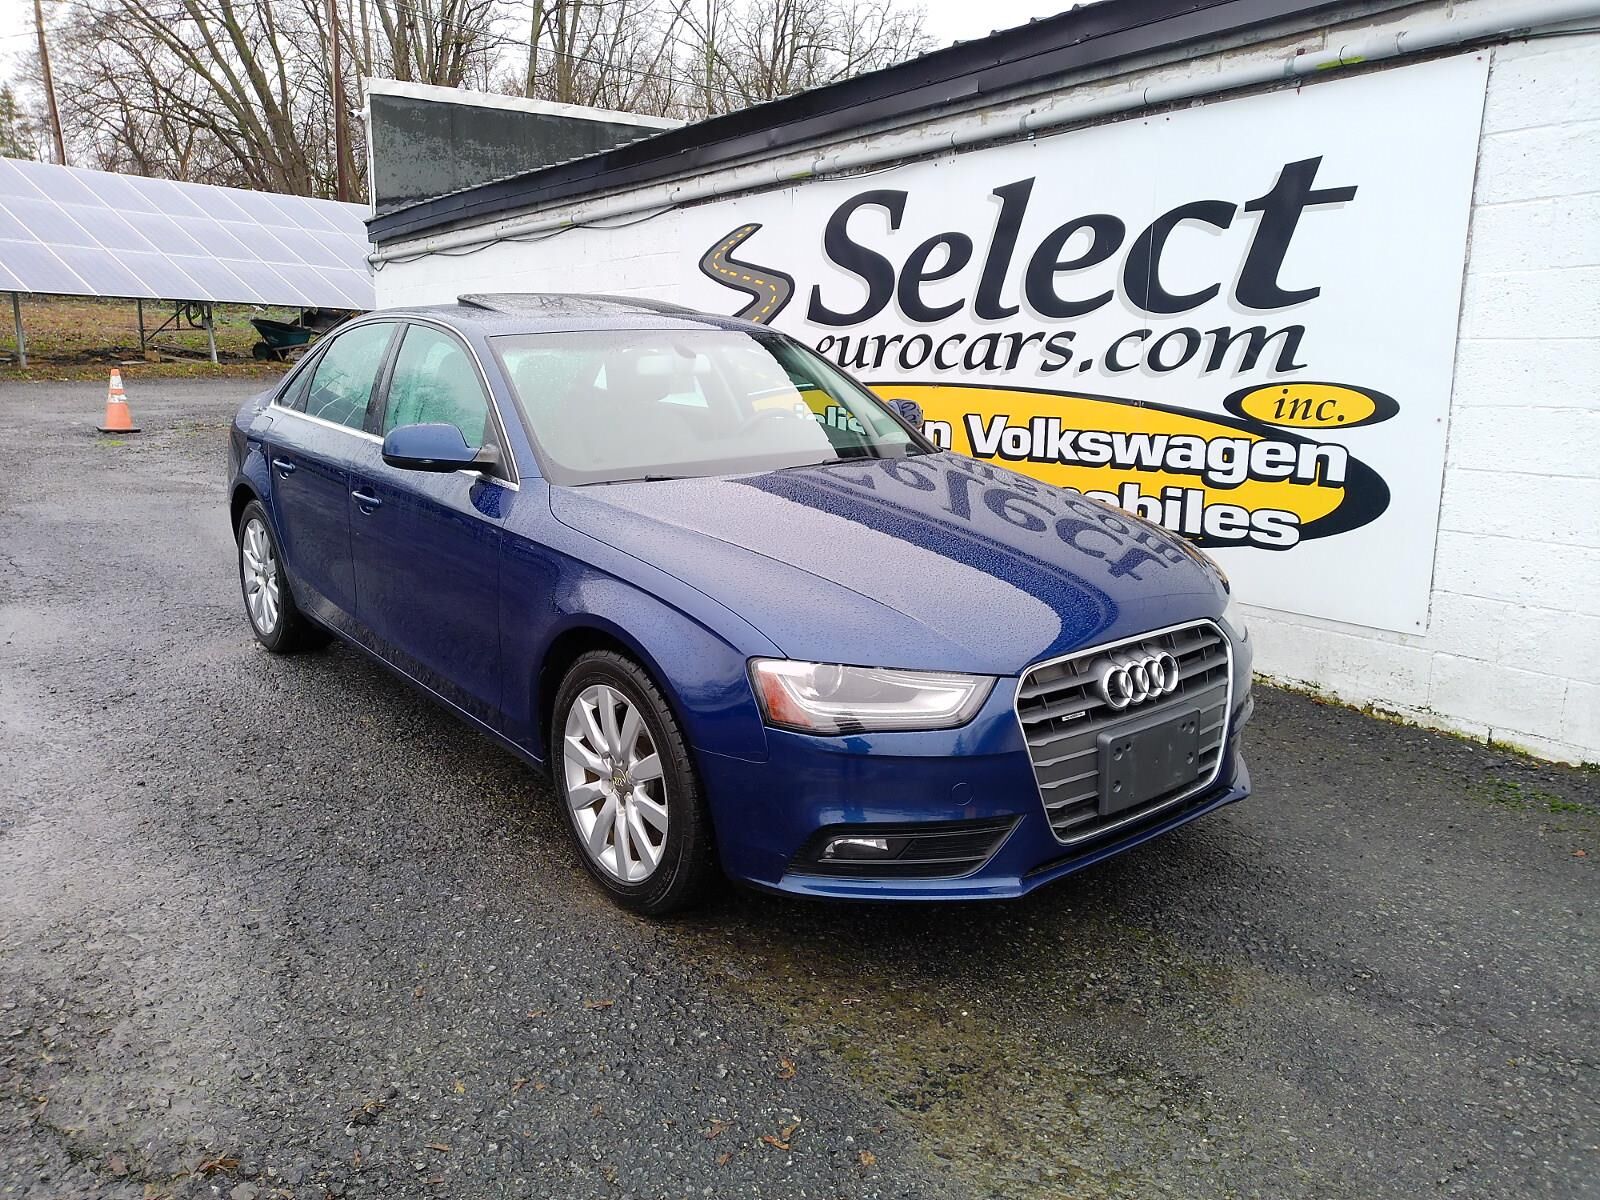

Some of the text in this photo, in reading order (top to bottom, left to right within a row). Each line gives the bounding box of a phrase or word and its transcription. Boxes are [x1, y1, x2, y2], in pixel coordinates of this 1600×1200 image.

[806, 155, 1357, 326] Select
[1272, 393, 1346, 424] inc.
[919, 414, 1349, 490] n Volkswagen
[1062, 481, 1302, 550] biles
